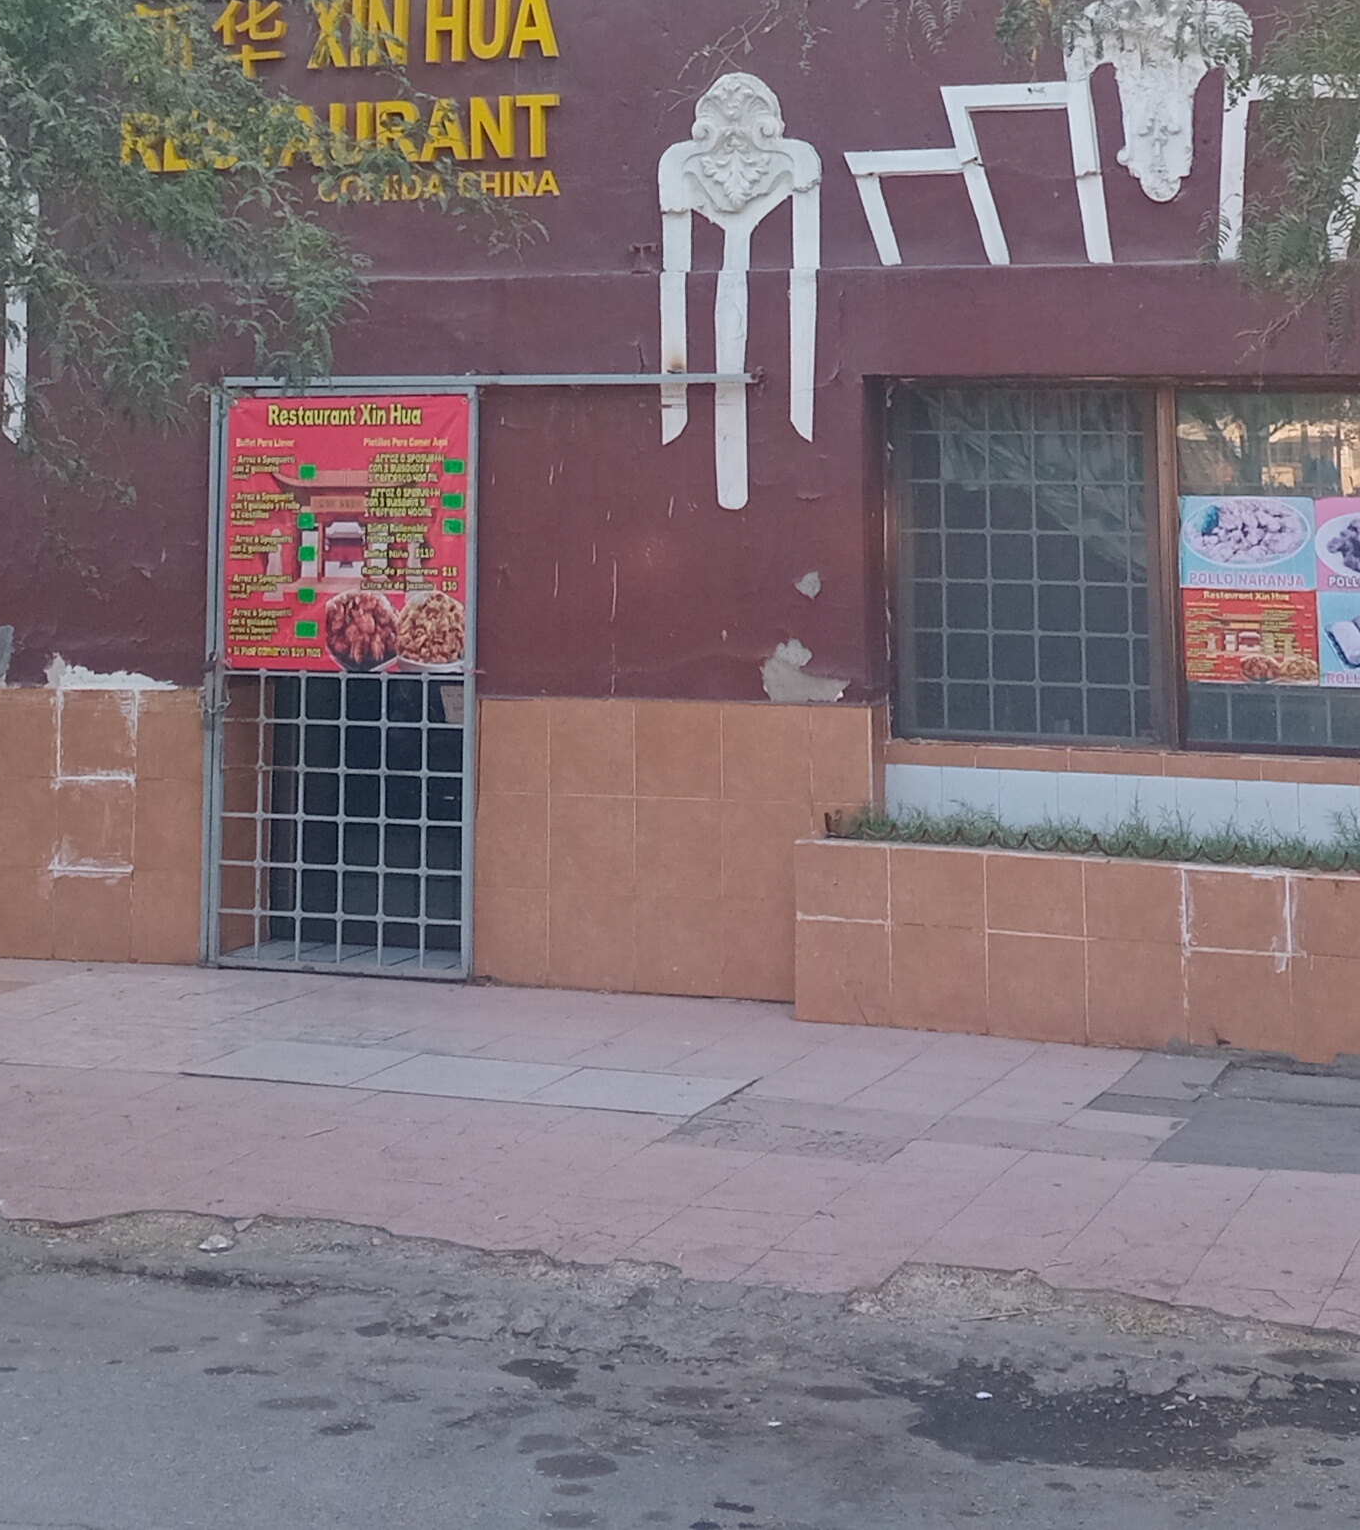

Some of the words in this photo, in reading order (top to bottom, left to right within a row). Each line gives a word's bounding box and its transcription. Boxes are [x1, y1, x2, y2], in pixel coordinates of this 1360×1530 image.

[457, 169, 561, 199] CHINA
[268, 404, 356, 426] Restaurant
[360, 404, 387, 425] Xin
[390, 404, 422, 425] Hua
[363, 437, 391, 447] Platillos
[392, 437, 408, 447] Para
[362, 567, 383, 576] Rollo
[384, 567, 395, 576] de
[1189, 572, 1233, 587] POLLO
[1239, 572, 1305, 587] NARANJA
